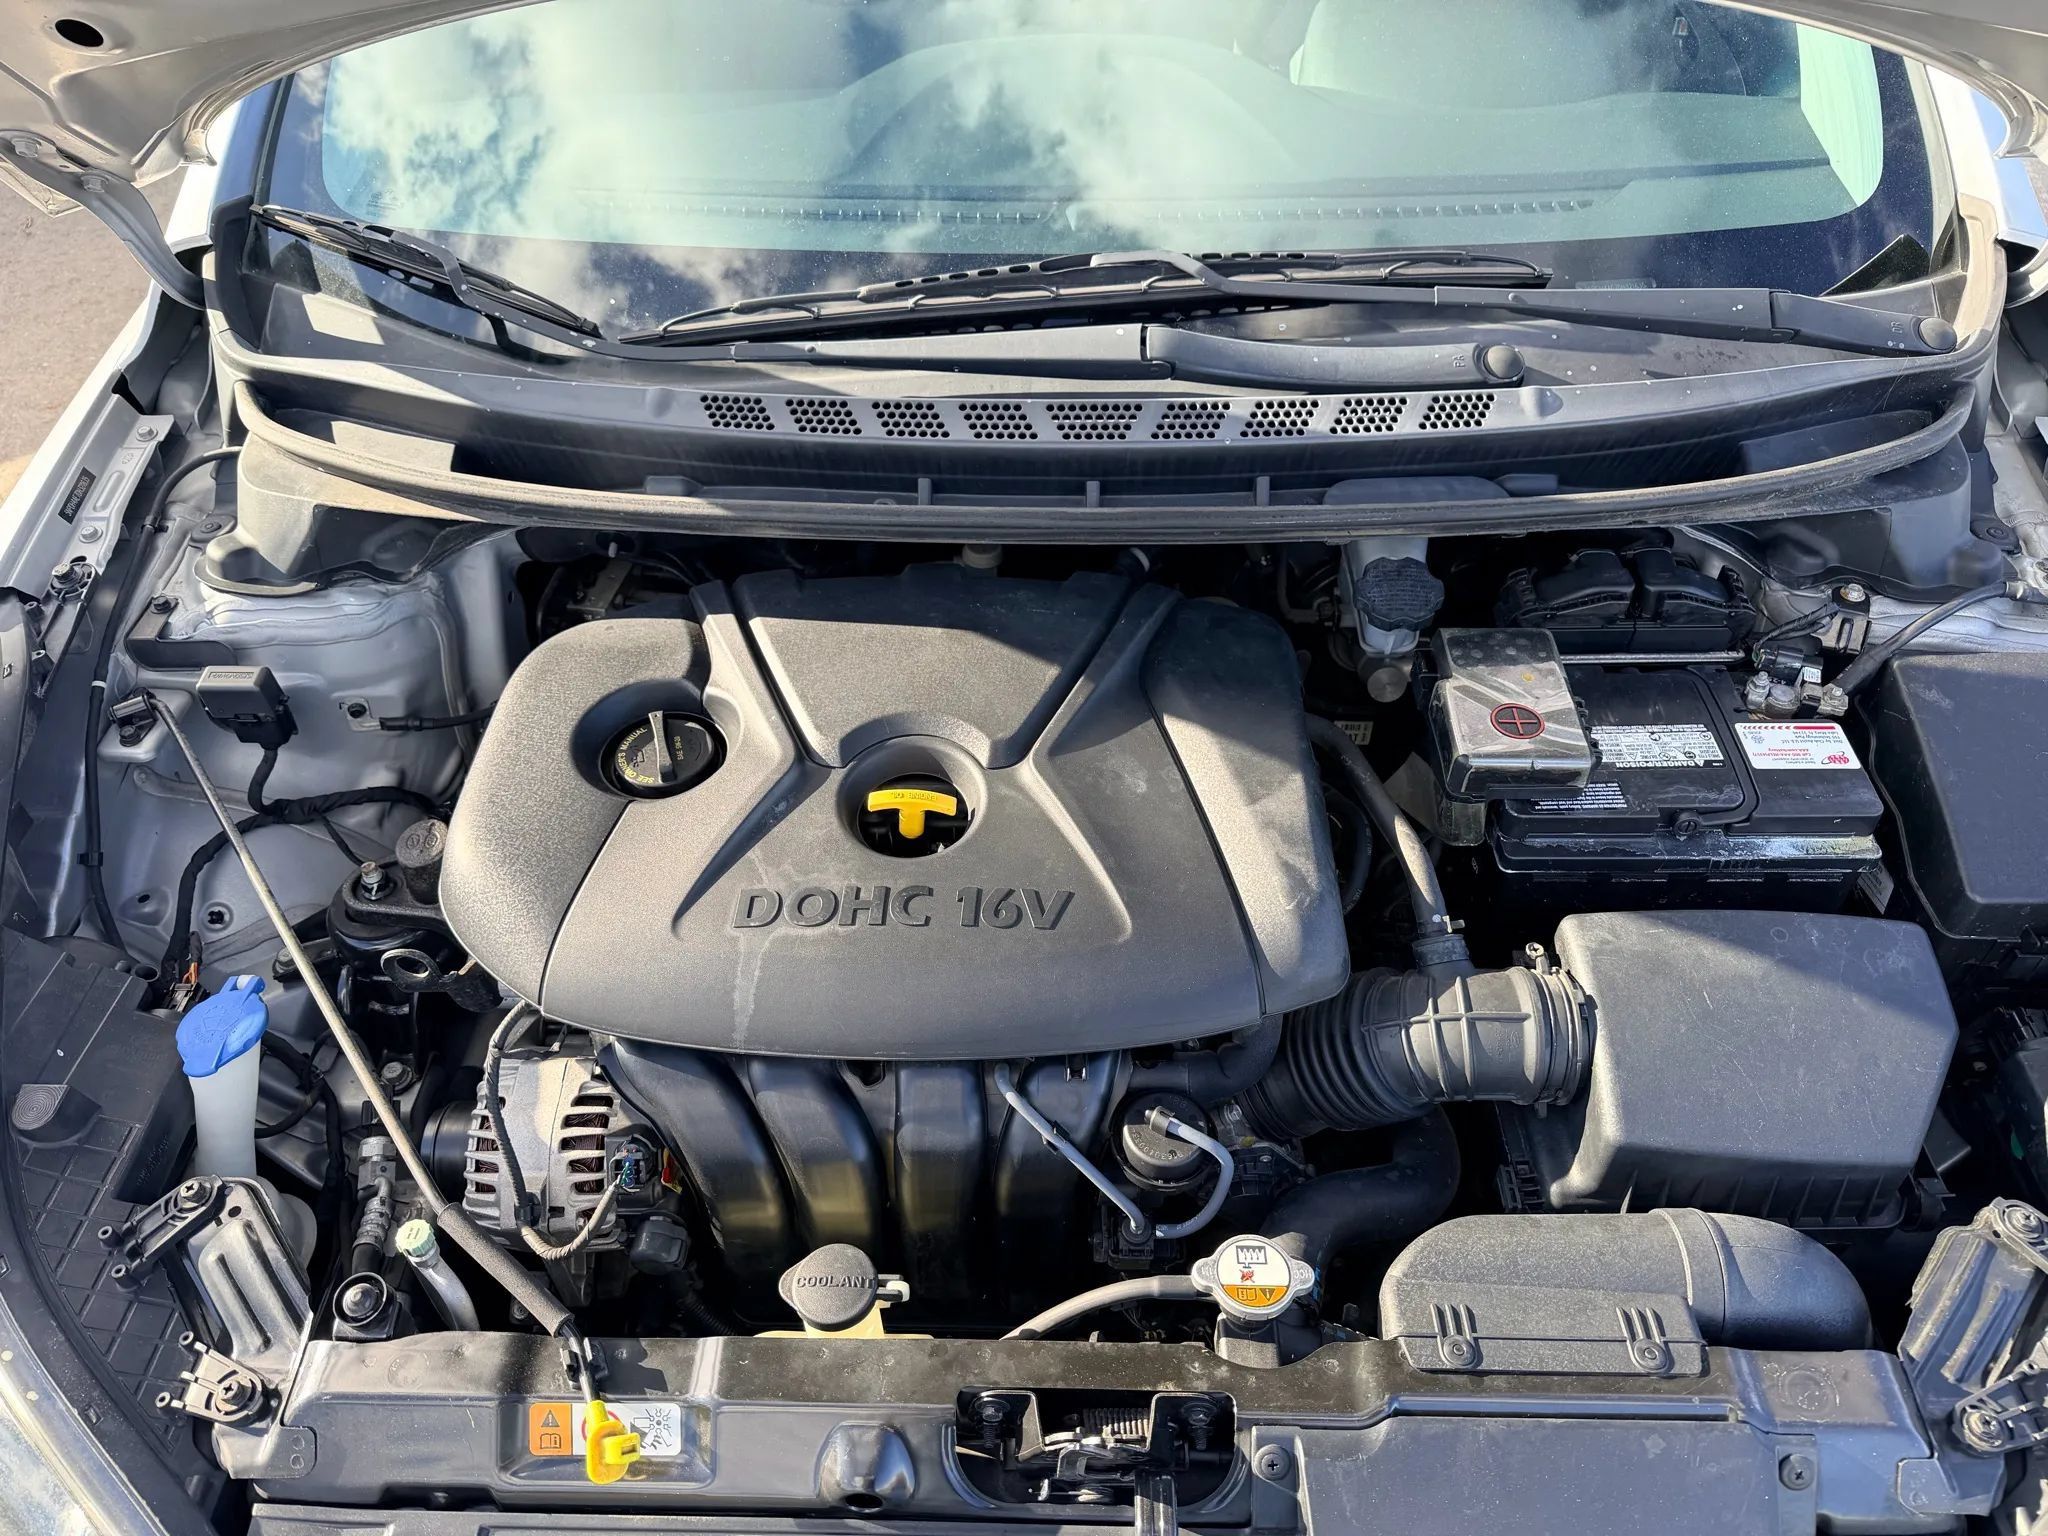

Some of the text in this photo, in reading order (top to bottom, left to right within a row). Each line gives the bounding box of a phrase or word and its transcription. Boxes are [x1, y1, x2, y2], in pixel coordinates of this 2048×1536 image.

[617, 727, 655, 784] SEE OWNER'S MANUAL
[1829, 754, 1849, 765] AAA
[1615, 760, 1696, 768] DANGER/POISON
[907, 792, 938, 800] ENGINE
[732, 885, 1075, 930] DOHC 16V
[796, 1275, 875, 1289] COOLANT
